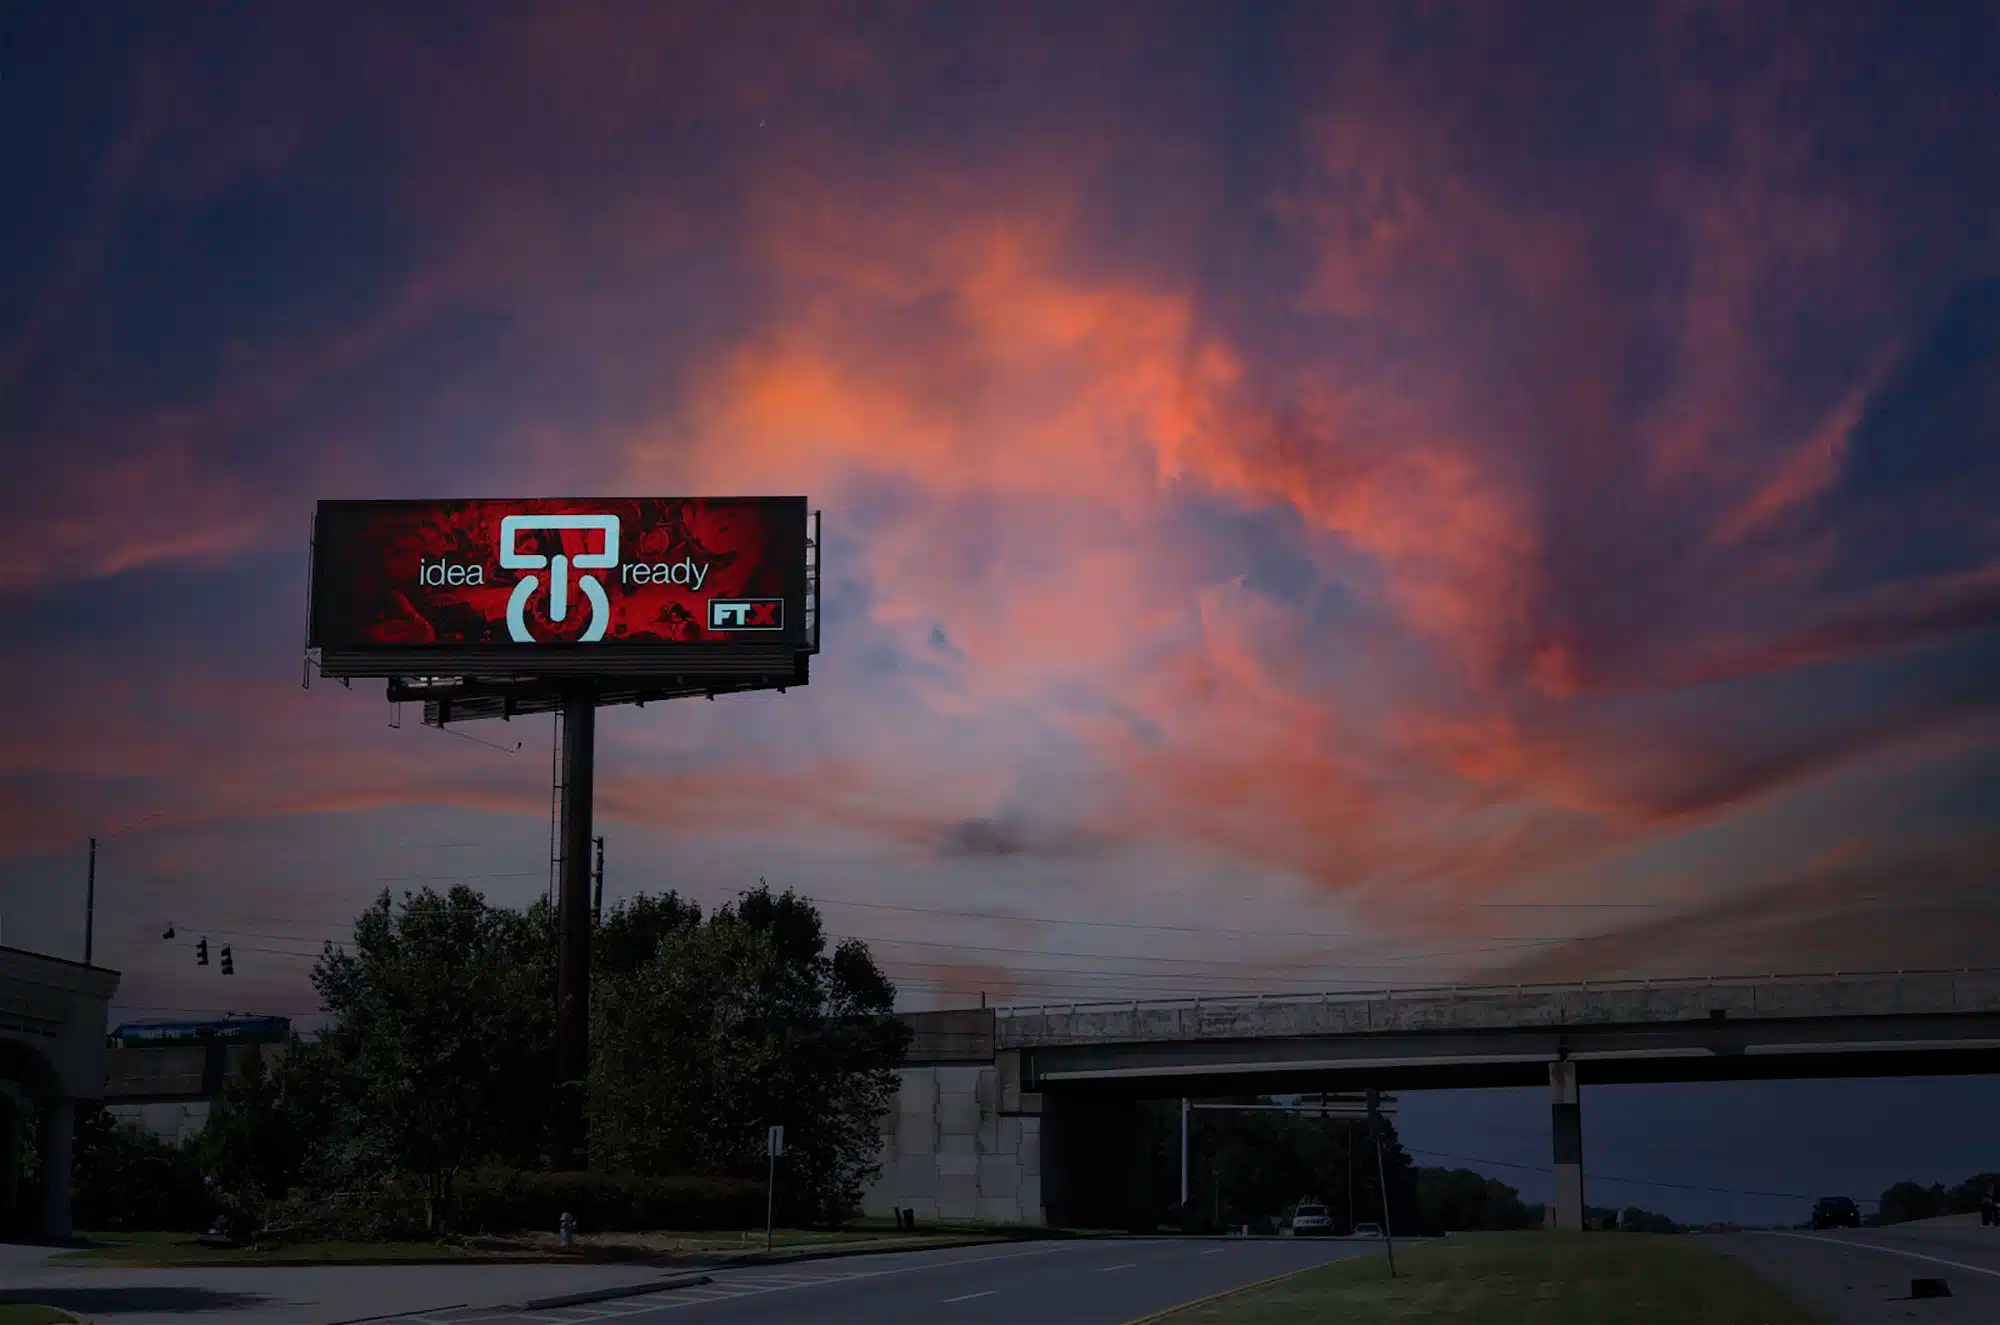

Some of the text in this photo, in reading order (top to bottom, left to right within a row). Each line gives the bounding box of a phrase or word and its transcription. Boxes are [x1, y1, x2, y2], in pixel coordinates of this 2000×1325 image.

[419, 558, 709, 590] idea ready
[713, 603, 777, 626] FTX
